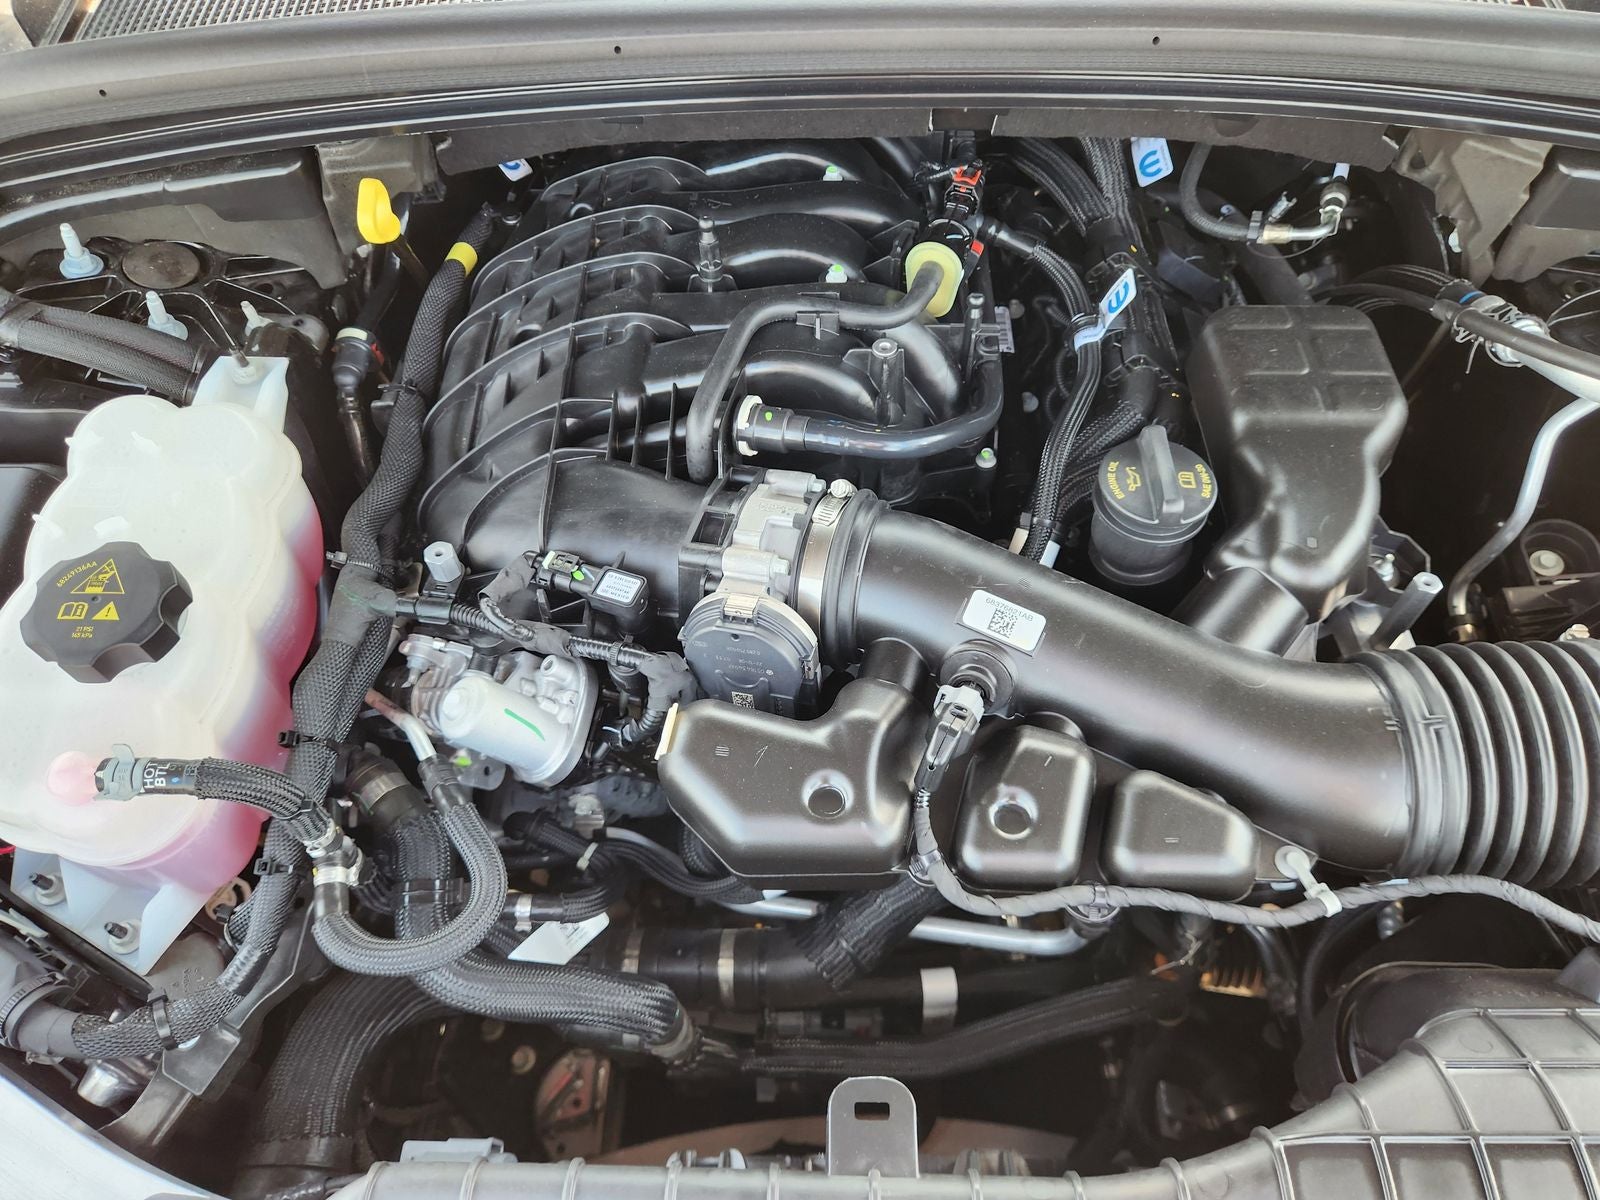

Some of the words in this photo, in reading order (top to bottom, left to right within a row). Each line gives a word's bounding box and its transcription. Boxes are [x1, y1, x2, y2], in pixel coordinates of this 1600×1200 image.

[1108, 461, 1119, 472] OIL
[1107, 472, 1125, 499] ENGINE
[1201, 483, 1212, 498] SAE
[144, 761, 157, 788] HOT
[155, 762, 170, 787] BTL
